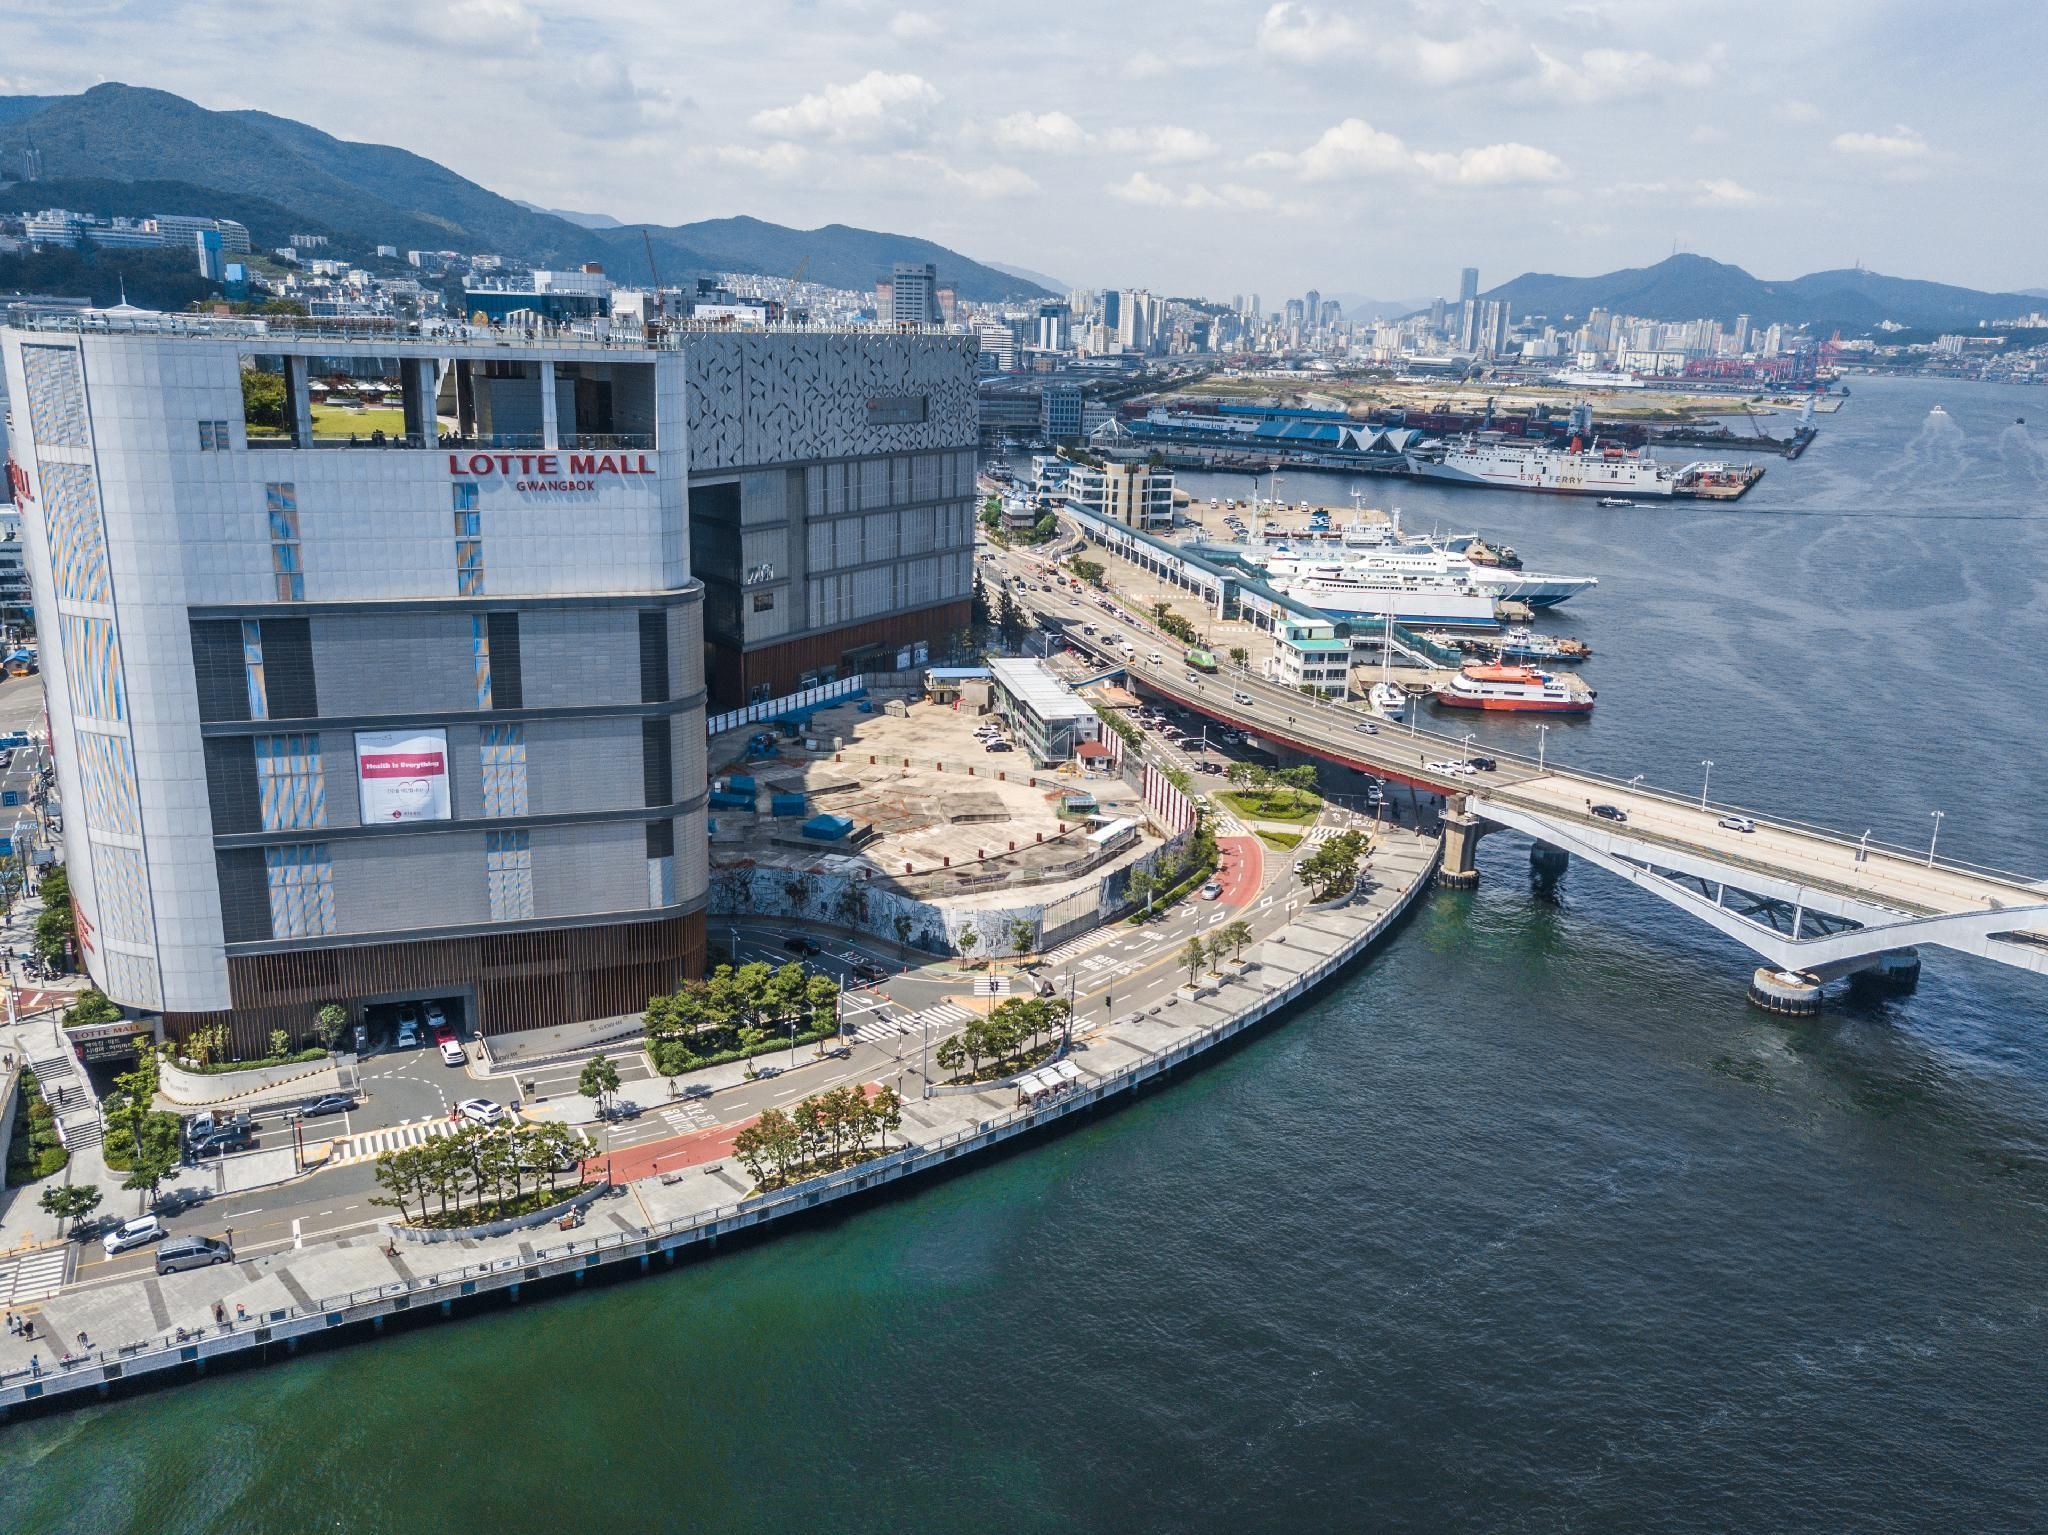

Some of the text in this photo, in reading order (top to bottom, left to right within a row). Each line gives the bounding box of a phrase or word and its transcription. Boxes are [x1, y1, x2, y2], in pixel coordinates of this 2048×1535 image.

[449, 454, 656, 476] LOTTE MALL
[516, 480, 595, 492] GWANGBOK
[1549, 475, 1583, 485] FERRY
[366, 762, 391, 770] Health
[400, 761, 440, 769] Everything
[840, 951, 869, 963] BUS
[75, 1024, 142, 1040] LOTTE MALL
